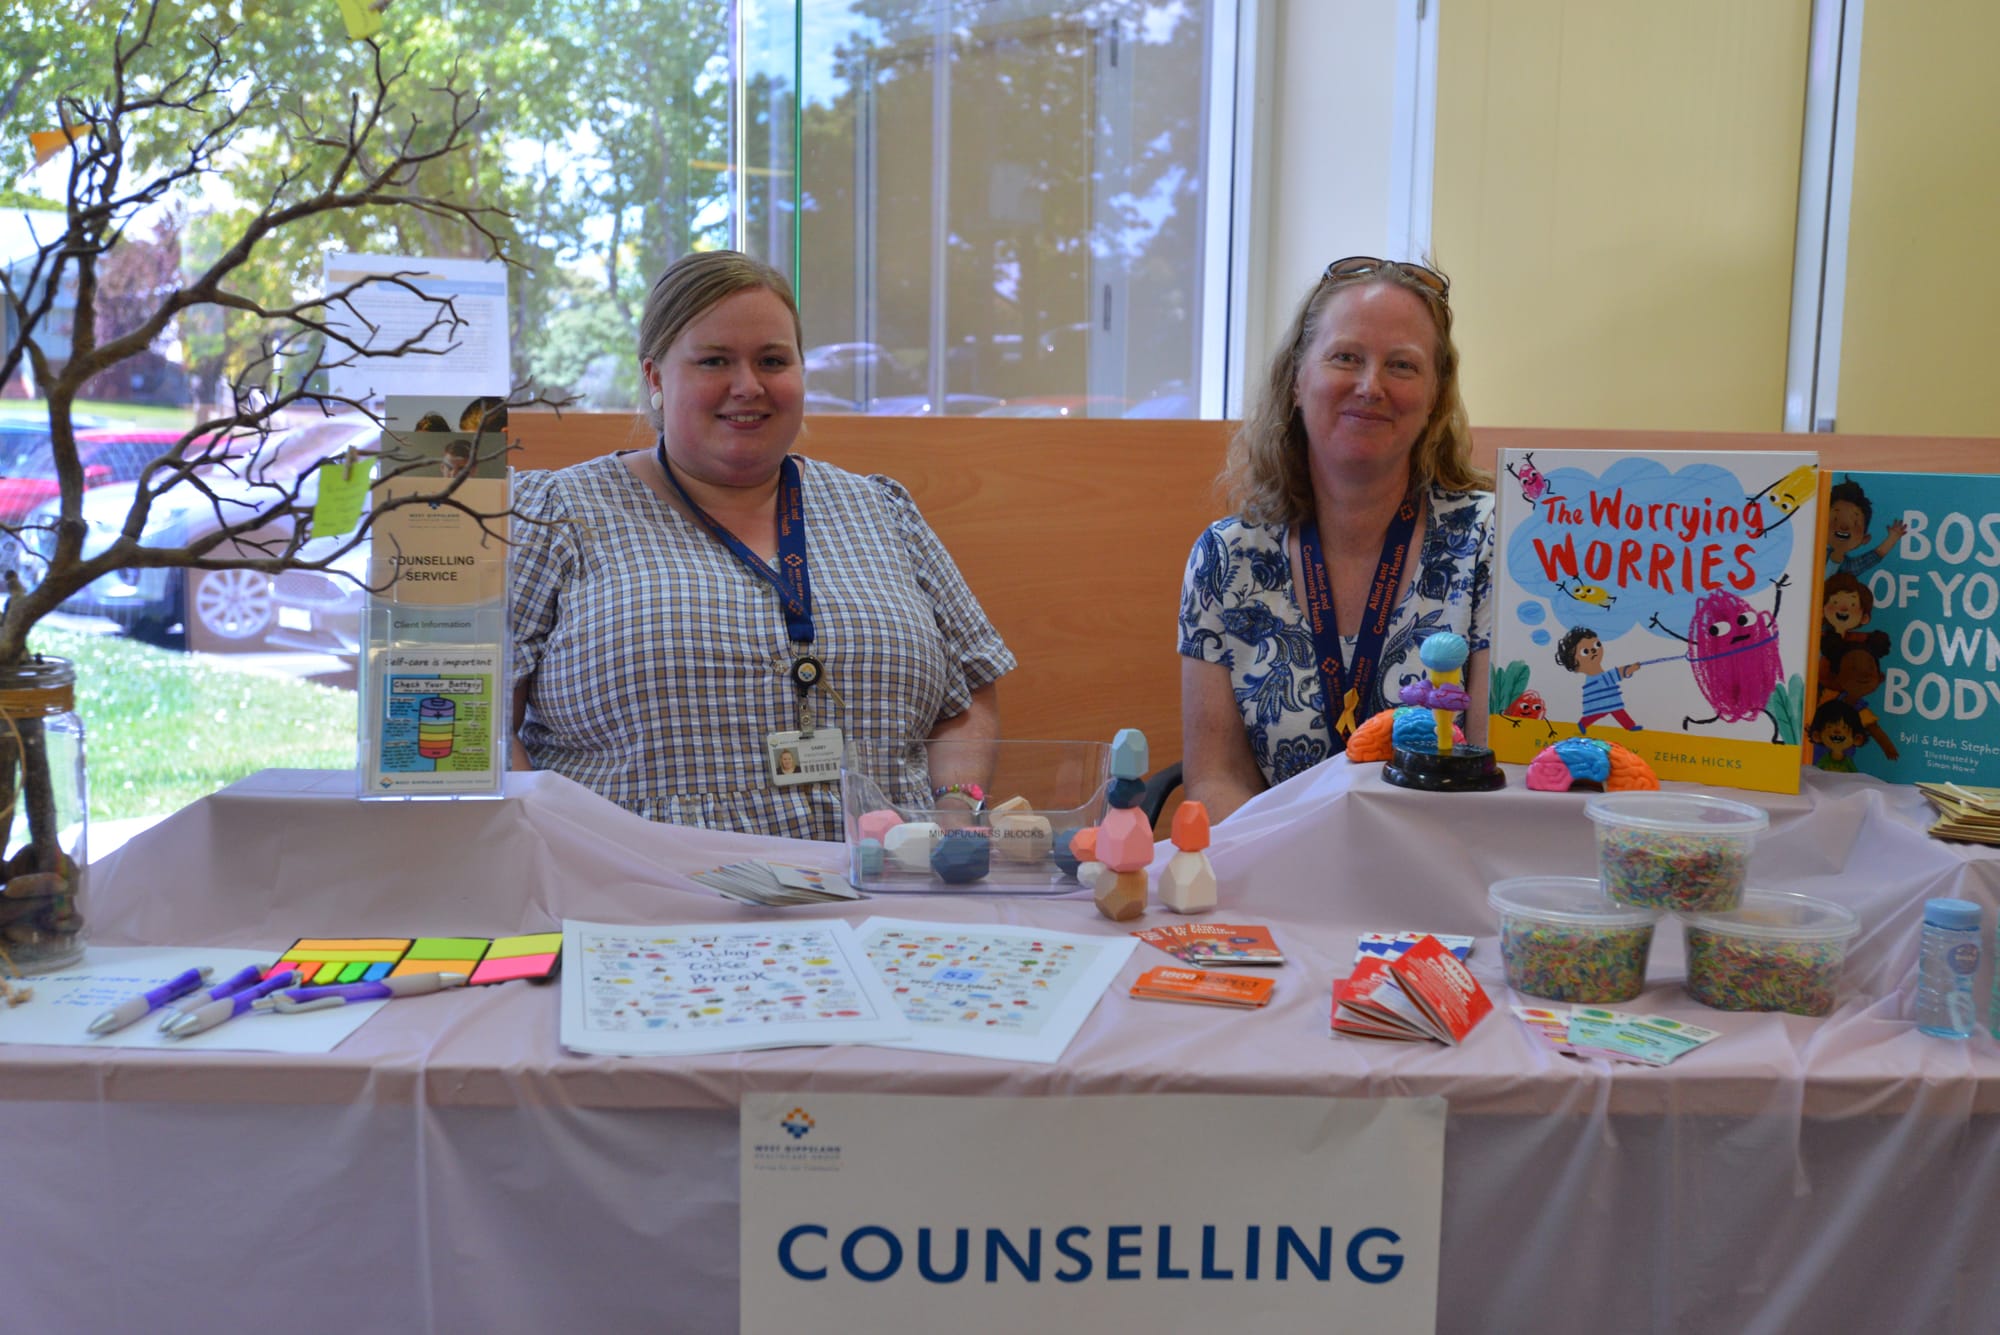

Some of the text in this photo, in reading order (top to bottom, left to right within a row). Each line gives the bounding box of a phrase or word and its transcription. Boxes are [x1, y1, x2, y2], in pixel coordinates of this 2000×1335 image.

[1541, 487, 1765, 543] The Worrying
[389, 556, 475, 566] COUNSELLING
[406, 571, 458, 581] SERVICE
[1532, 532, 1756, 595] WORRIES
[1303, 544, 1325, 634] Community Health
[1315, 563, 1332, 611] Allied and
[1368, 562, 1390, 611] Allied and
[1373, 543, 1406, 635] Community Health
[1869, 569, 1920, 609] OF
[393, 619, 472, 629] Client Information
[443, 656, 493, 668] important
[1654, 751, 1697, 765] ZEHRA
[1702, 756, 1743, 769] HICKS
[1933, 735, 1958, 749] Beth
[928, 828, 1045, 839] MINDFULNESS BLOCKS
[778, 1223, 1405, 1285] COUNSELLING
